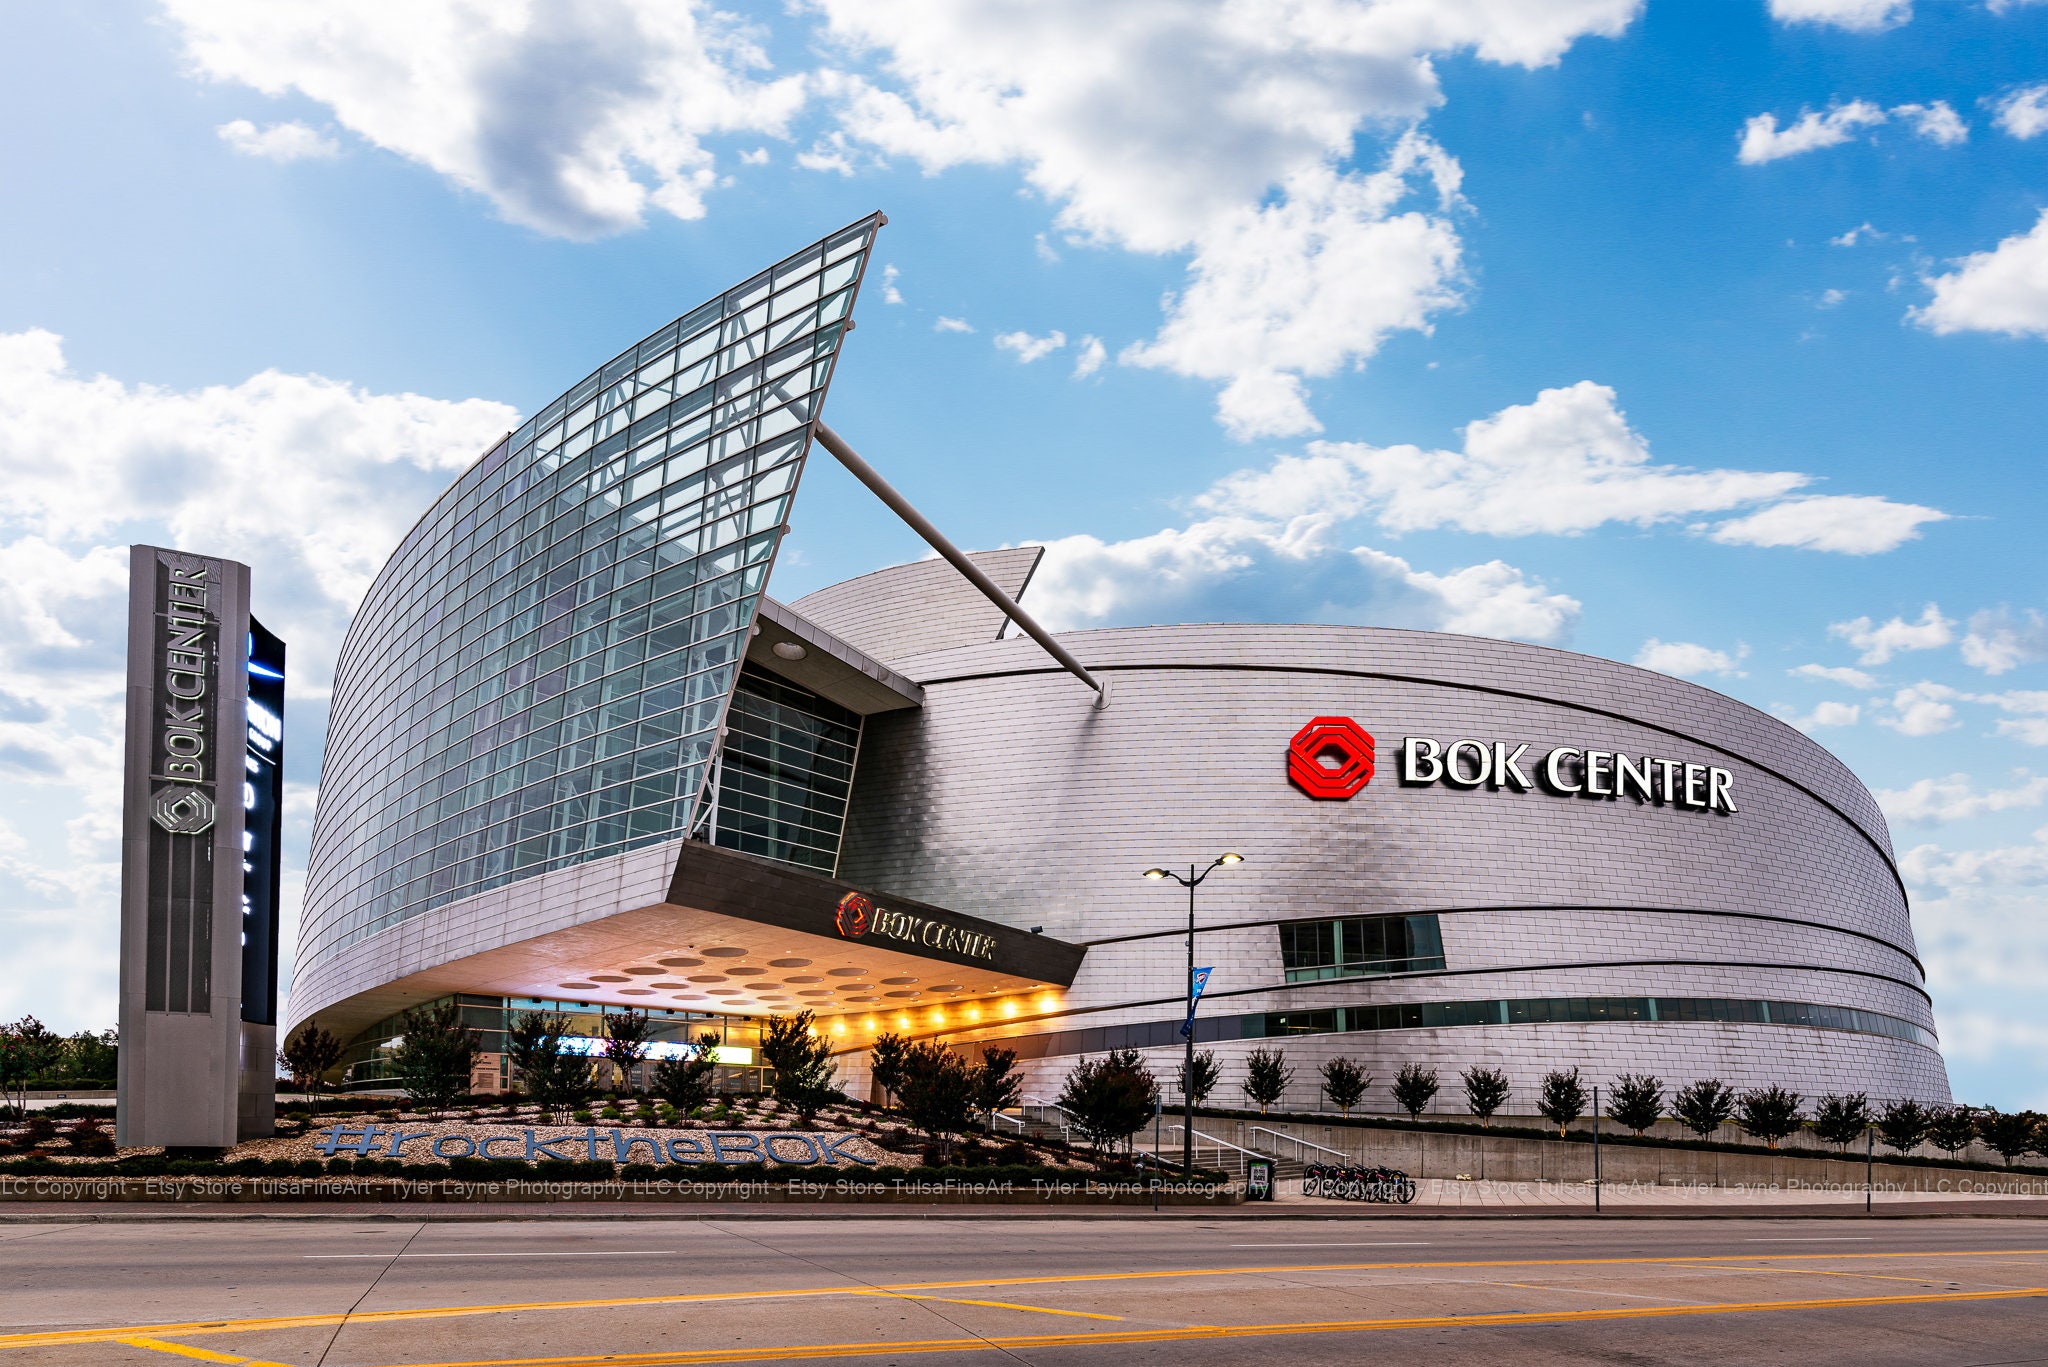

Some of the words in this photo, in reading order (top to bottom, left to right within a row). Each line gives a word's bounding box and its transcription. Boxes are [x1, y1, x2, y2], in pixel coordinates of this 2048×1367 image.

[165, 561, 208, 700] CENTER
[164, 688, 204, 783] BOK
[1403, 736, 1533, 789] BOK
[1546, 746, 1739, 813] CENTER
[871, 907, 922, 943] BOK
[922, 921, 997, 960] CENTER
[313, 1124, 876, 1165] #rocktheBOK
